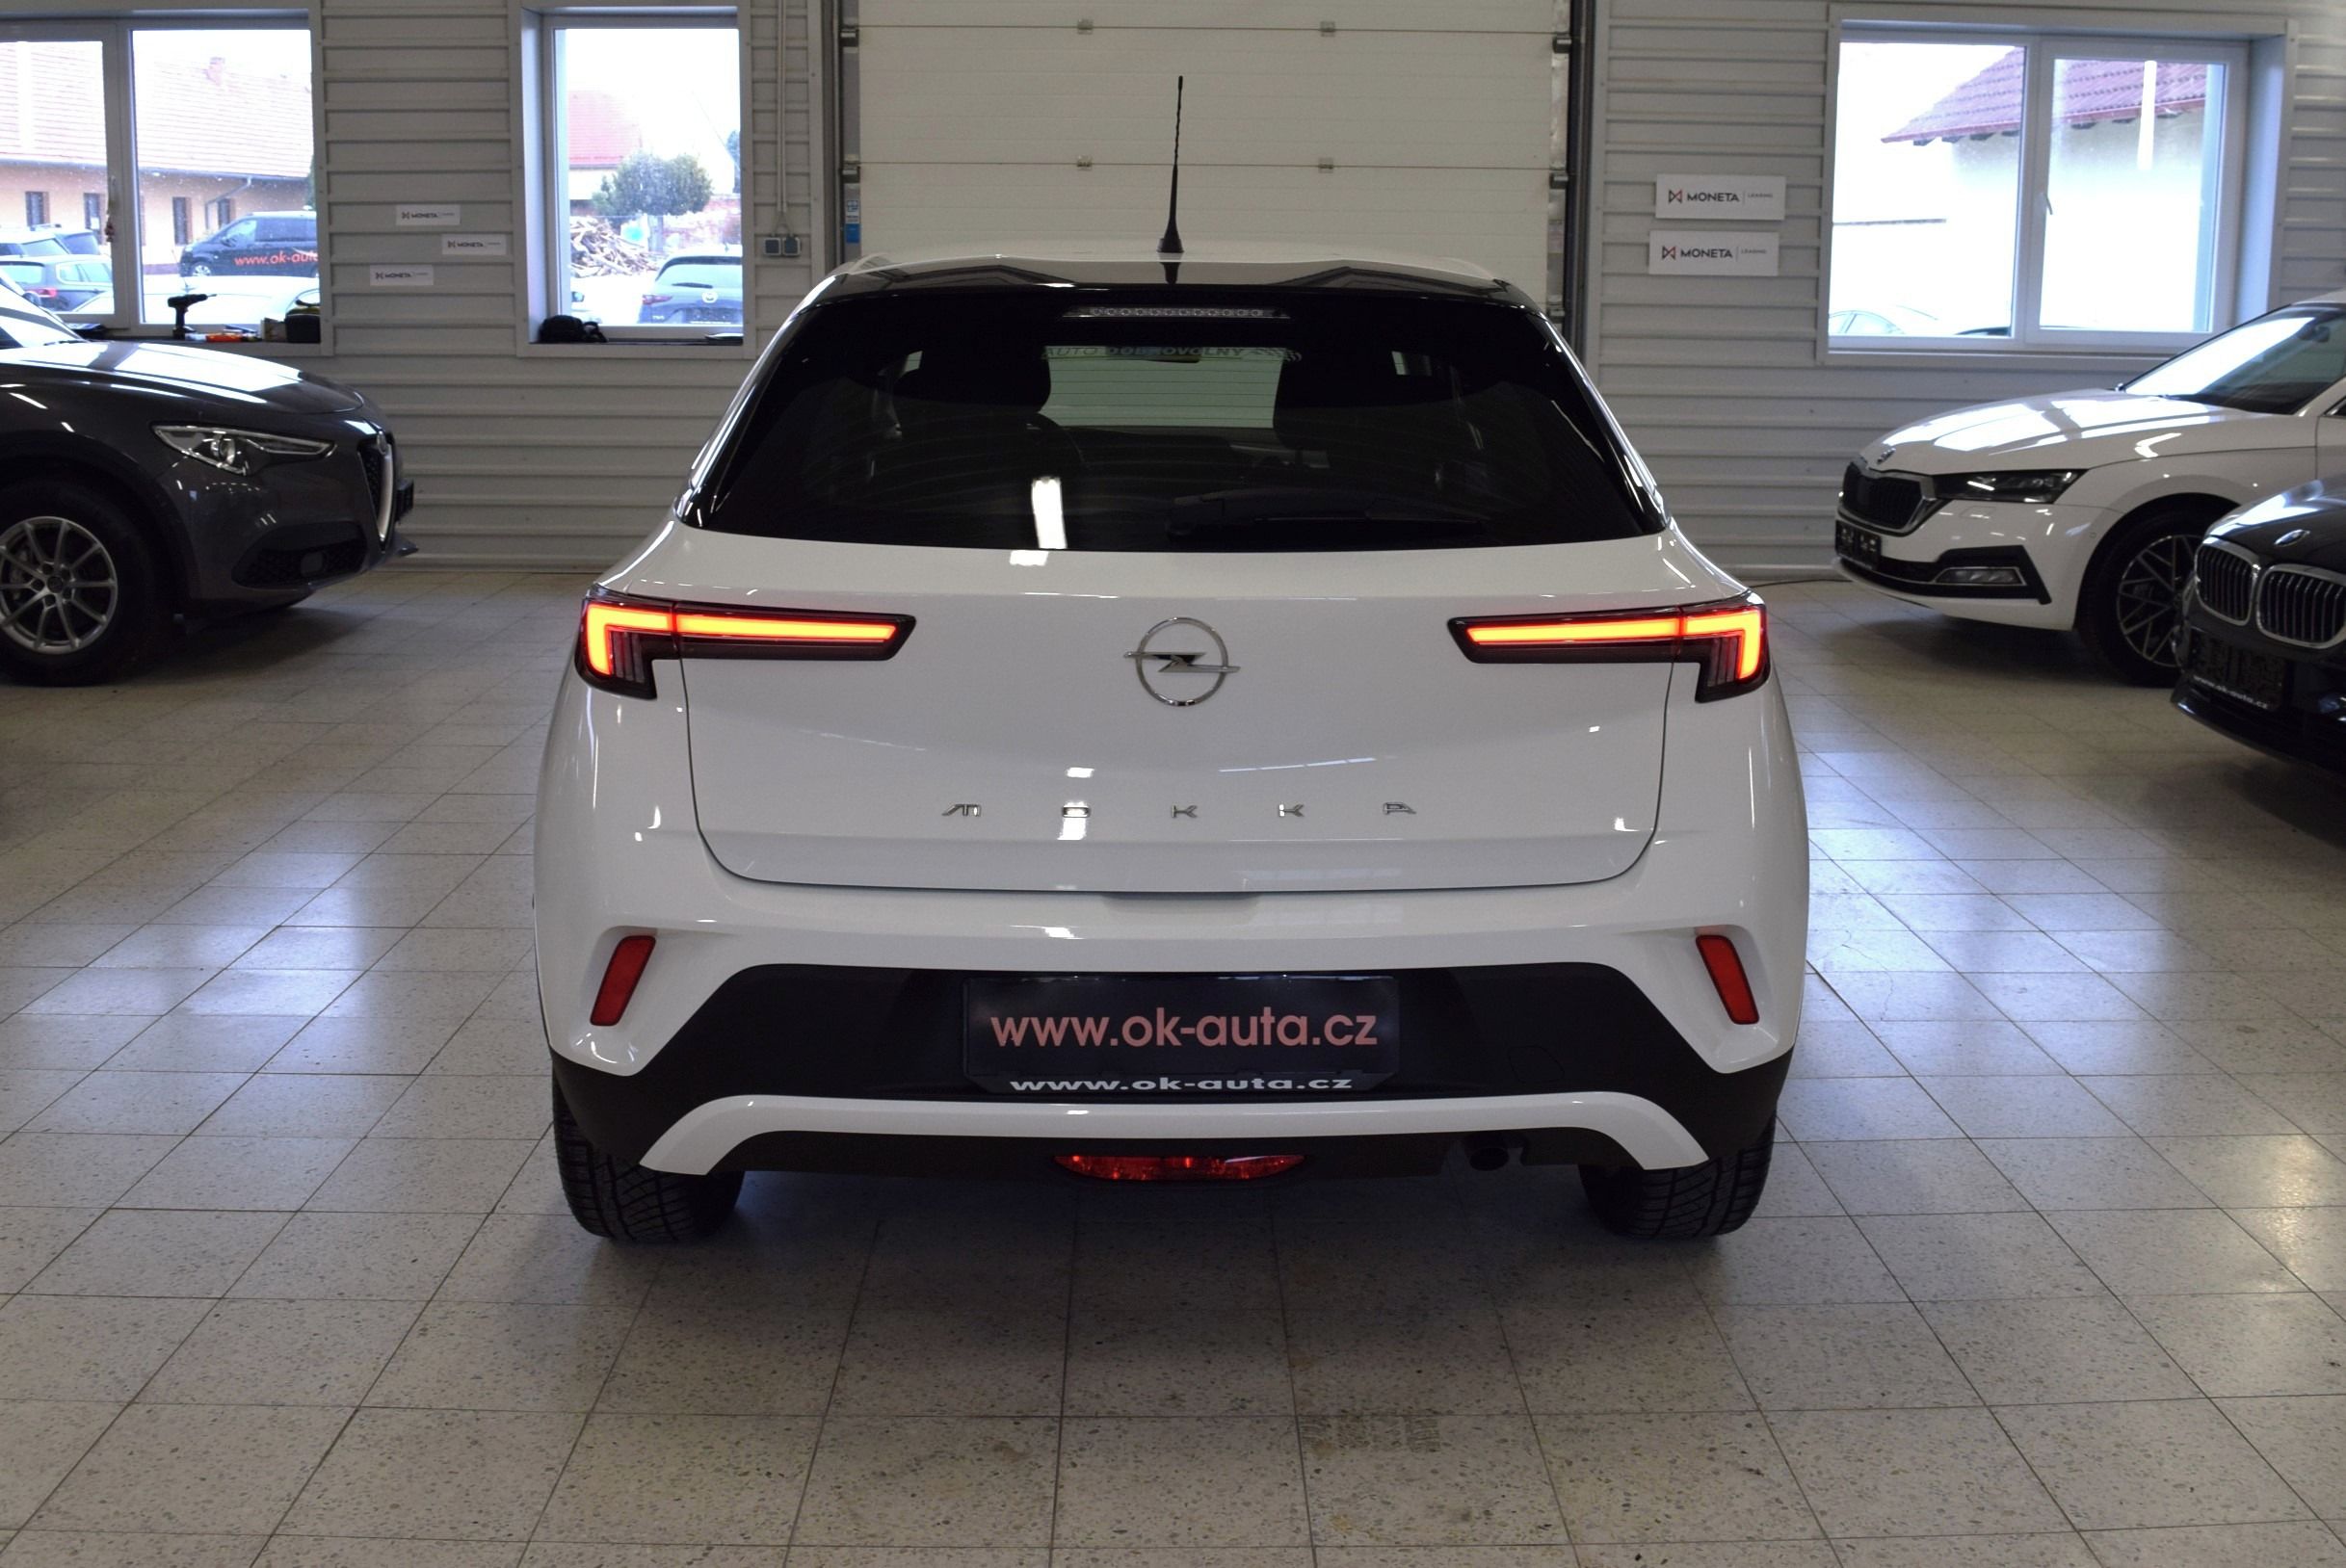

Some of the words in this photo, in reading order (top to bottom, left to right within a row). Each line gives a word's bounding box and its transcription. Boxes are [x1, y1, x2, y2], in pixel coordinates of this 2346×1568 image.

[1686, 192, 1740, 203] MONETA
[1680, 248, 1733, 259] MONETA
[990, 1006, 1378, 1047] www.ok-auta.cz
[1010, 1077, 1352, 1091] www.ok-auta.cz
